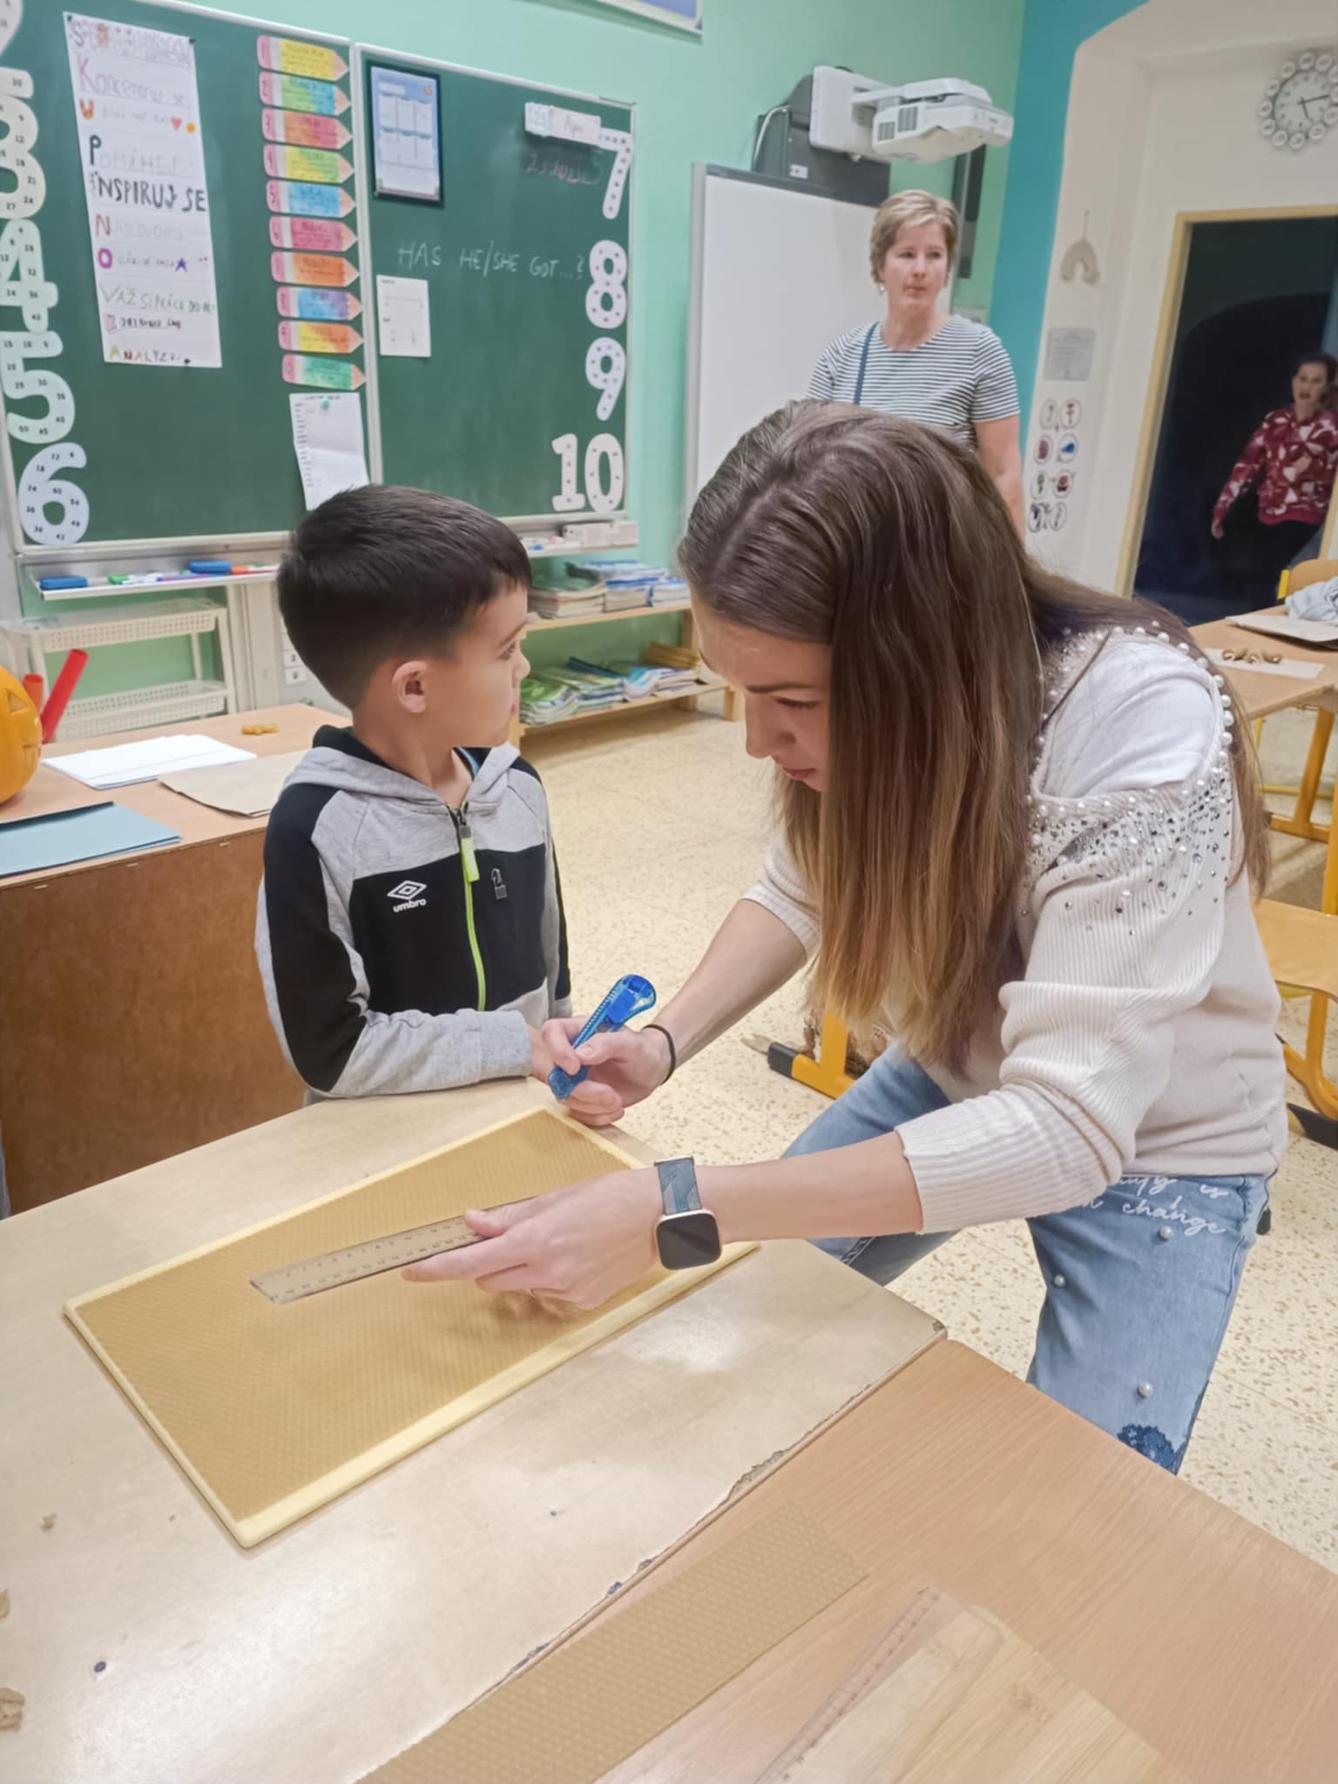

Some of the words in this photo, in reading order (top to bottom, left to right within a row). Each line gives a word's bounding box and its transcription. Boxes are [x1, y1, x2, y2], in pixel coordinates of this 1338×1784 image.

[181, 187, 206, 212] SE
[0, 218, 59, 335] 4
[397, 241, 442, 270] HAS
[459, 239, 520, 277] HE/SHE
[585, 239, 627, 330] 8
[0, 330, 76, 445] 5
[585, 336, 626, 421] 9
[18, 441, 90, 547] 6
[551, 432, 624, 513] 10
[392, 897, 427, 913] umbro
